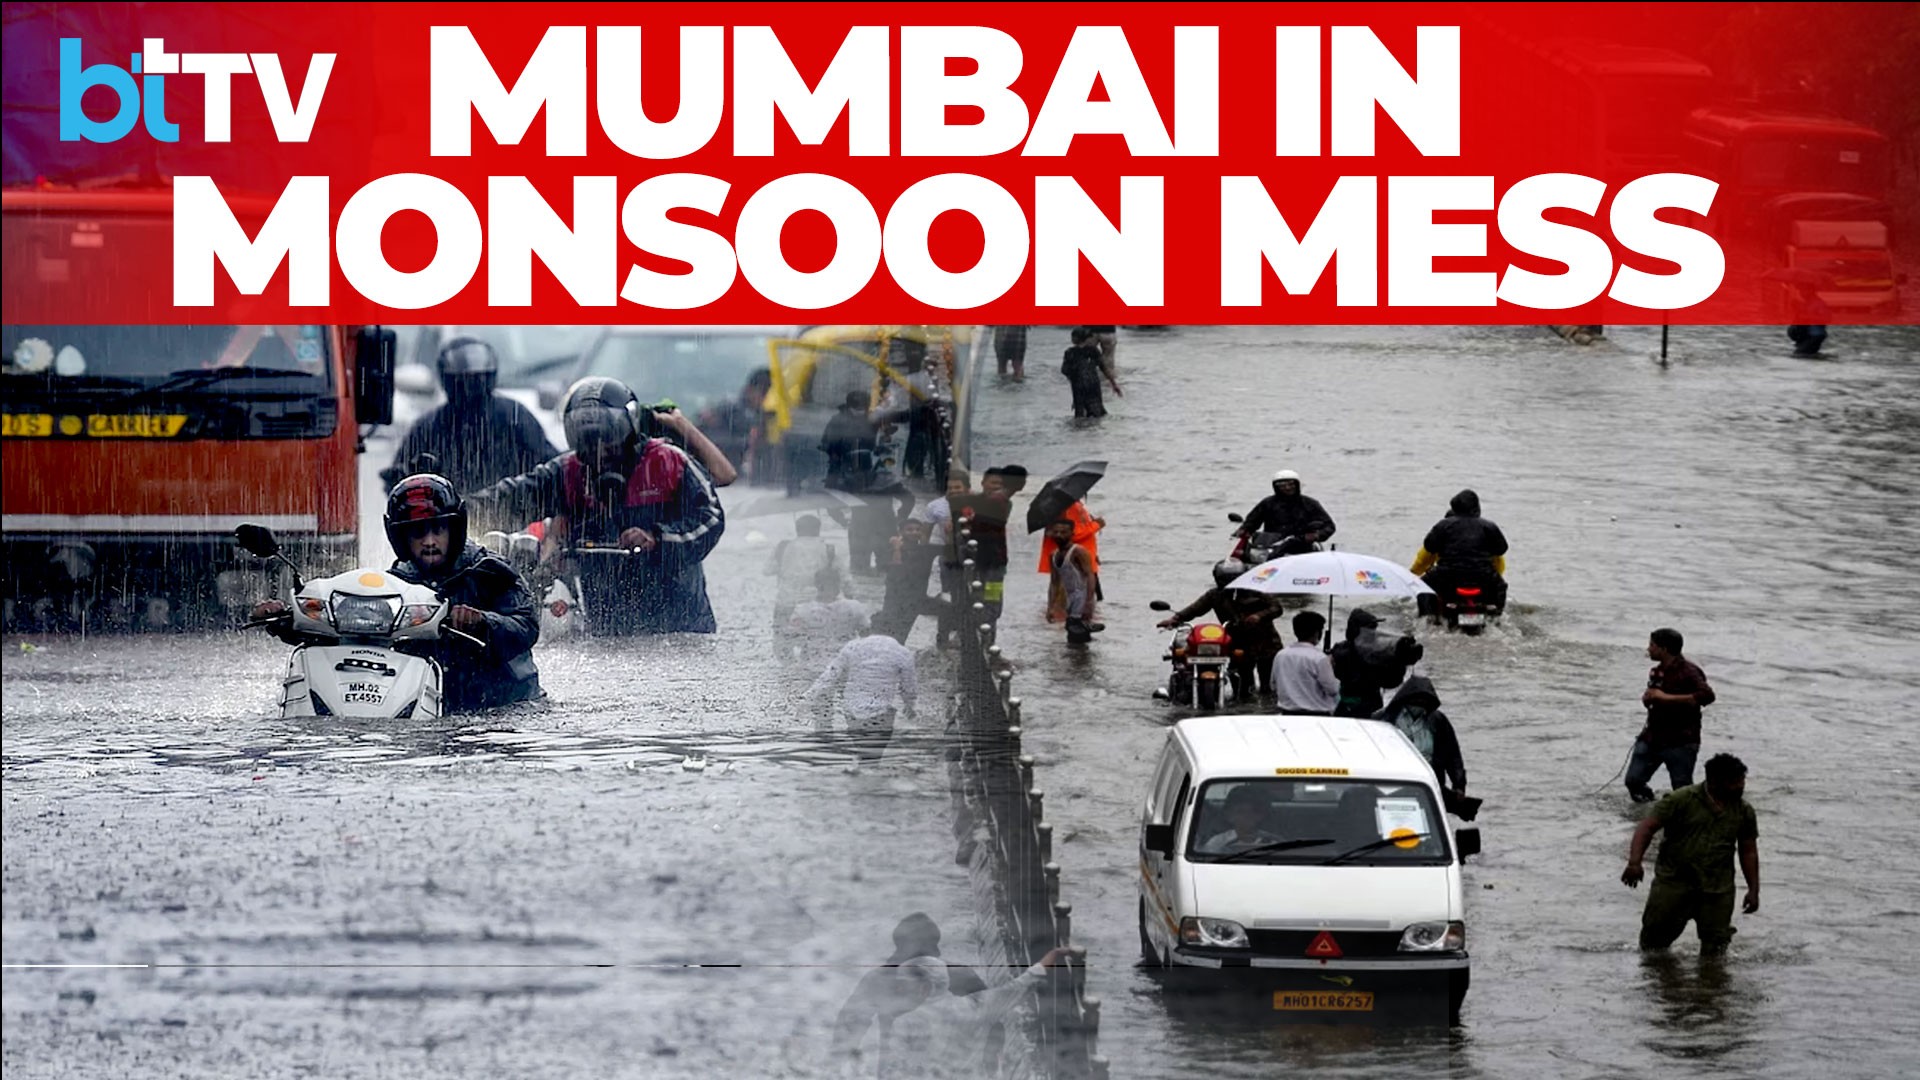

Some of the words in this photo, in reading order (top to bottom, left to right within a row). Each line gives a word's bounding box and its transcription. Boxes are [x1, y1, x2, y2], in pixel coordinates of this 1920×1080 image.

[91, 414, 169, 434] CARRIER
[1275, 767, 1308, 775] GOODS
[1309, 767, 1349, 776] CARRIER
